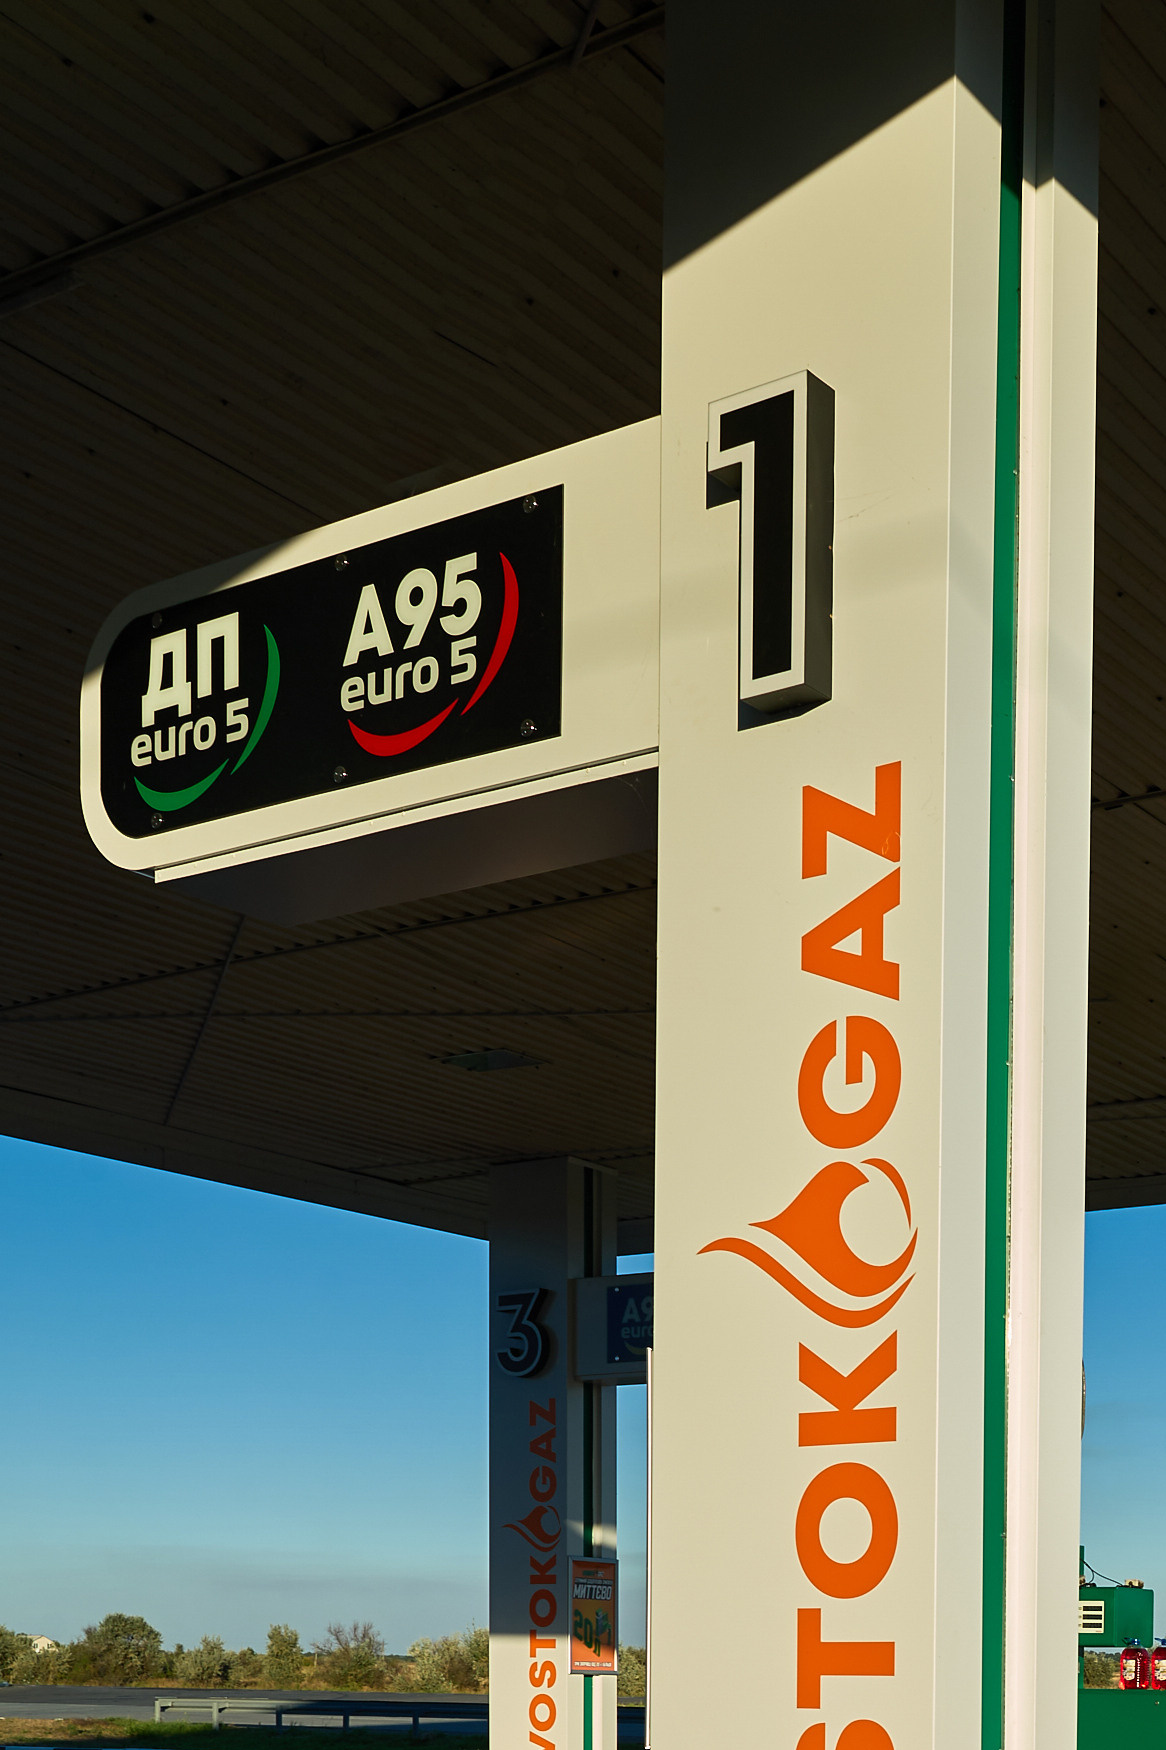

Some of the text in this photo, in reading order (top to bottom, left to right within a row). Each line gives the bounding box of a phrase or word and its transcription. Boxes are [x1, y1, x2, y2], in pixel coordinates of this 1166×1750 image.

[708, 370, 828, 701] 1
[343, 552, 482, 667] A95
[142, 612, 240, 728] ДП
[340, 636, 477, 712] euro 5
[131, 698, 249, 767] euro 5
[798, 761, 902, 1150] GAZ
[497, 1288, 549, 1378] 3
[529, 1398, 557, 1503] GAZ
